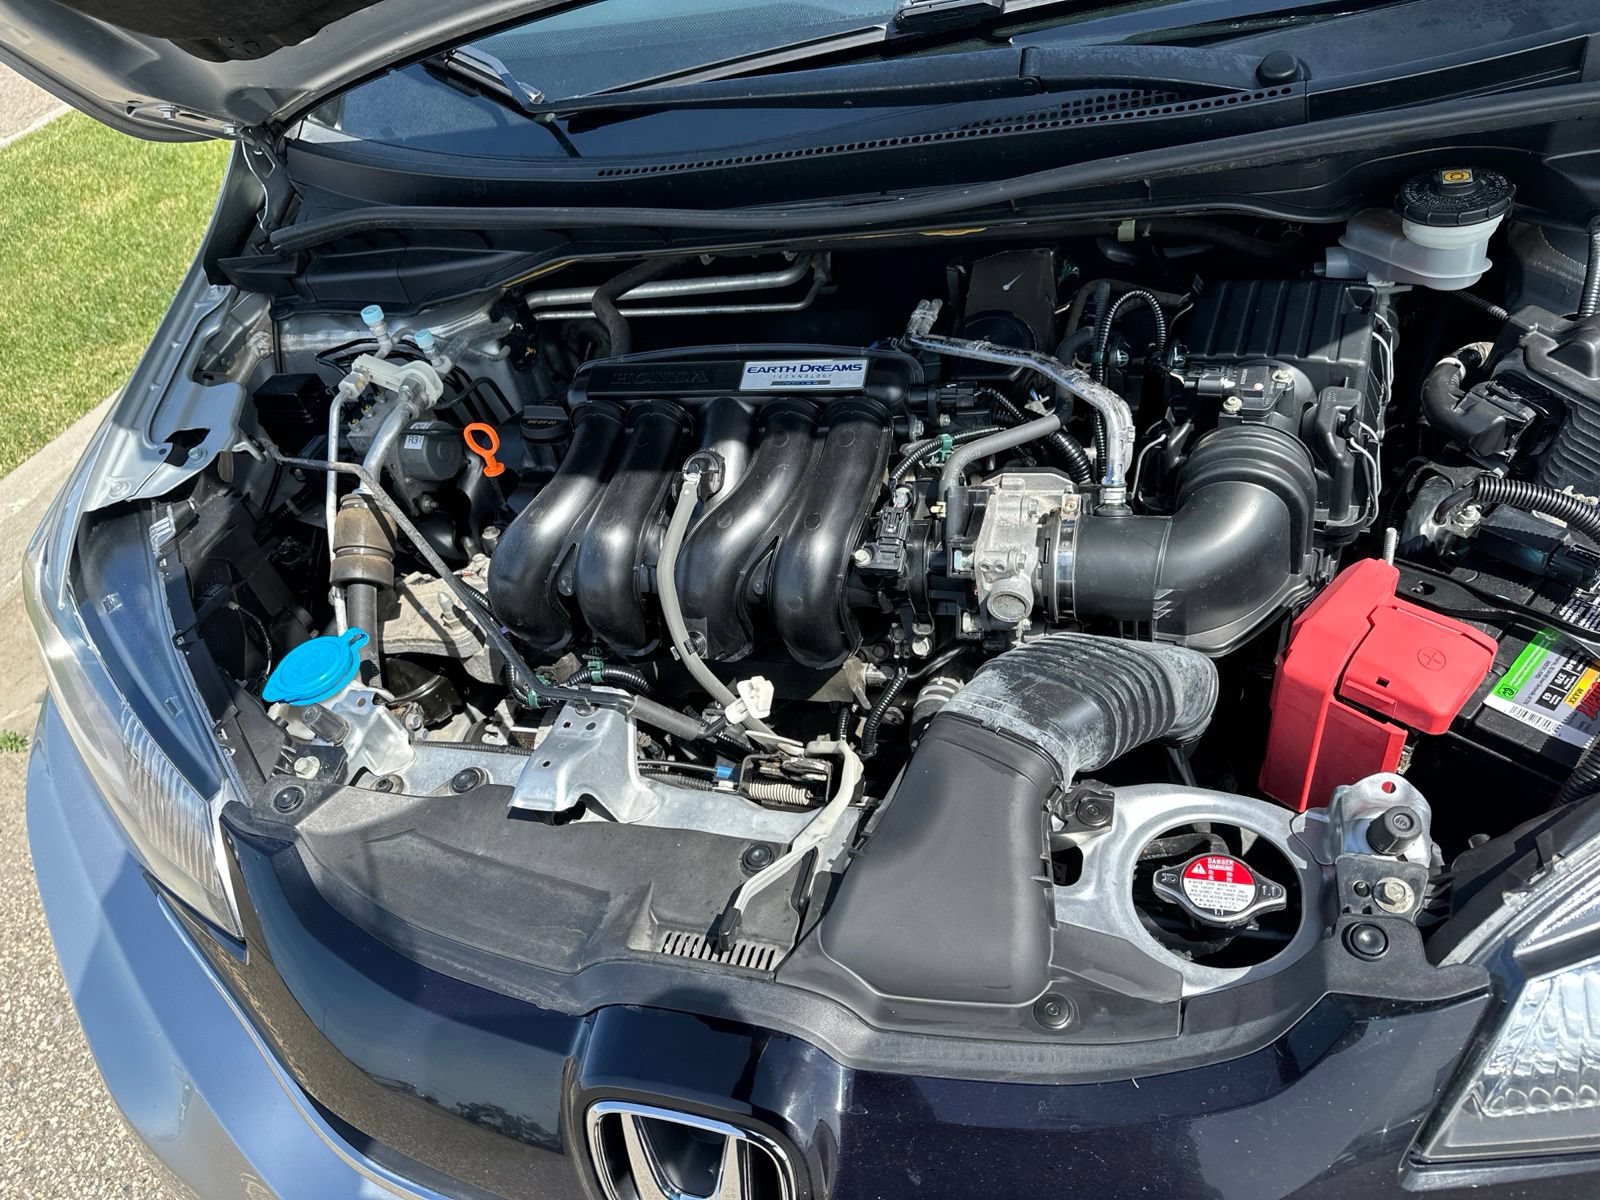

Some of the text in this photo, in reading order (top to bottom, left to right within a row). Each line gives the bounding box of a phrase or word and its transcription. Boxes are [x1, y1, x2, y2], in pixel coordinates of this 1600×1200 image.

[747, 364, 863, 374] EARTH DREAMS
[610, 370, 710, 385] HONDA
[1568, 687, 1585, 704] MAXX
[1208, 857, 1233, 866] DANGER
